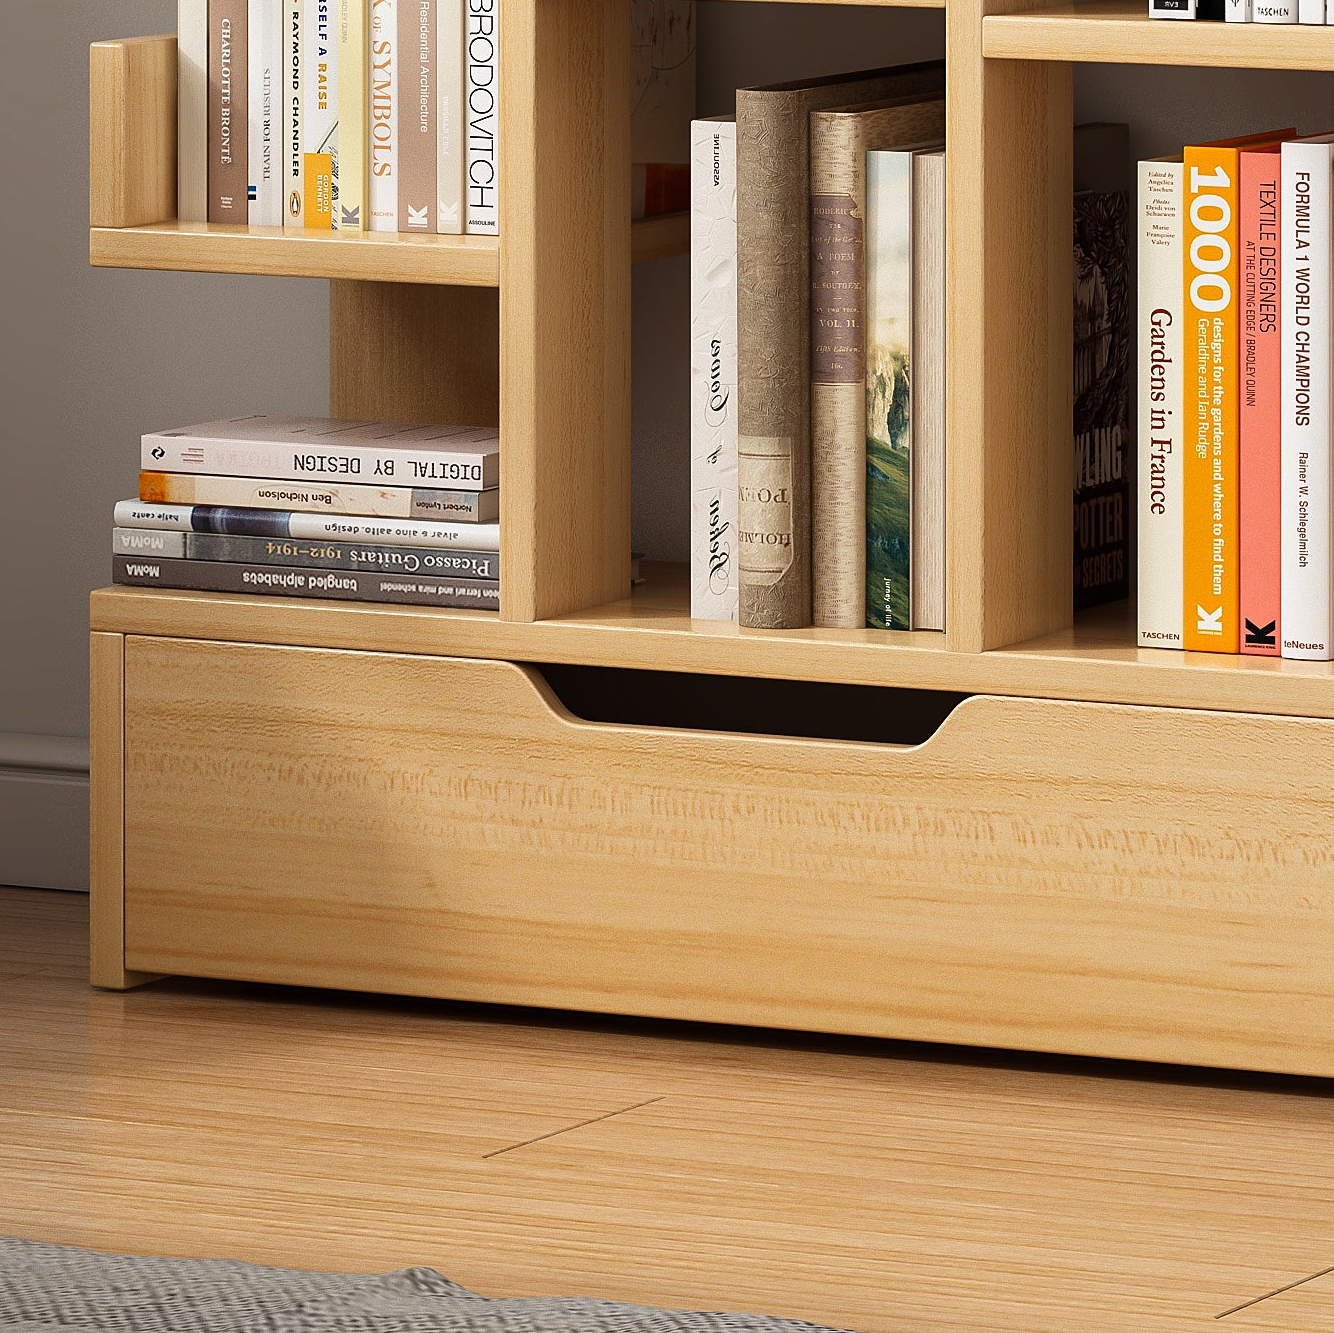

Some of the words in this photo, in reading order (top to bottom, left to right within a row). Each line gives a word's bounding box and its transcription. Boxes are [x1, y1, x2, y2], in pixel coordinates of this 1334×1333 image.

[370, 16, 382, 33] OF
[419, 0, 430, 63] Residential
[221, 18, 232, 105] CHARLOTTE
[292, 11, 300, 91] RAYMOND
[318, 46, 328, 57] A
[318, 63, 328, 110] RAISE
[419, 65, 431, 134] Architecture
[370, 40, 392, 177] SYMBOLS
[292, 96, 300, 177] CHANDLER
[1259, 179, 1277, 242] TEXTILE
[1295, 171, 1311, 250] FORMULA
[1189, 166, 1232, 312] 1000
[1259, 246, 1277, 333] DESIGNERS
[1295, 267, 1311, 327] WORLD
[1150, 308, 1173, 402] Gardens
[1198, 318, 1210, 374] Geraldine
[1210, 317, 1224, 364] designs
[1198, 375, 1210, 398] and
[1212, 366, 1225, 384] for
[1295, 330, 1311, 427] CHAMPIONS
[1198, 400, 1210, 420] Ian
[1212, 385, 1225, 406] the
[1150, 407, 1173, 431] in
[1210, 407, 1225, 456] gardens
[1195, 422, 1210, 459] Rudge
[293, 454, 361, 474] DESIGN
[373, 459, 395, 476] BY
[406, 460, 482, 481] DIGITAL
[1150, 436, 1173, 515] France
[1212, 458, 1224, 481] and
[1298, 452, 1309, 484] Rainer
[258, 490, 309, 503] Nicholson
[311, 490, 333, 505] Ben
[1212, 482, 1225, 521] where
[1298, 485, 1309, 498] W.
[1212, 522, 1224, 536] to
[1296, 500, 1309, 568] Schlegelmilch
[348, 549, 424, 571] Guitars
[1212, 538, 1225, 562] find
[125, 563, 162, 579] MoMA
[422, 554, 491, 578] Picasso
[1212, 564, 1224, 595] them
[1141, 631, 1180, 641] TASCHEN
[1283, 640, 1325, 651] teNeues
